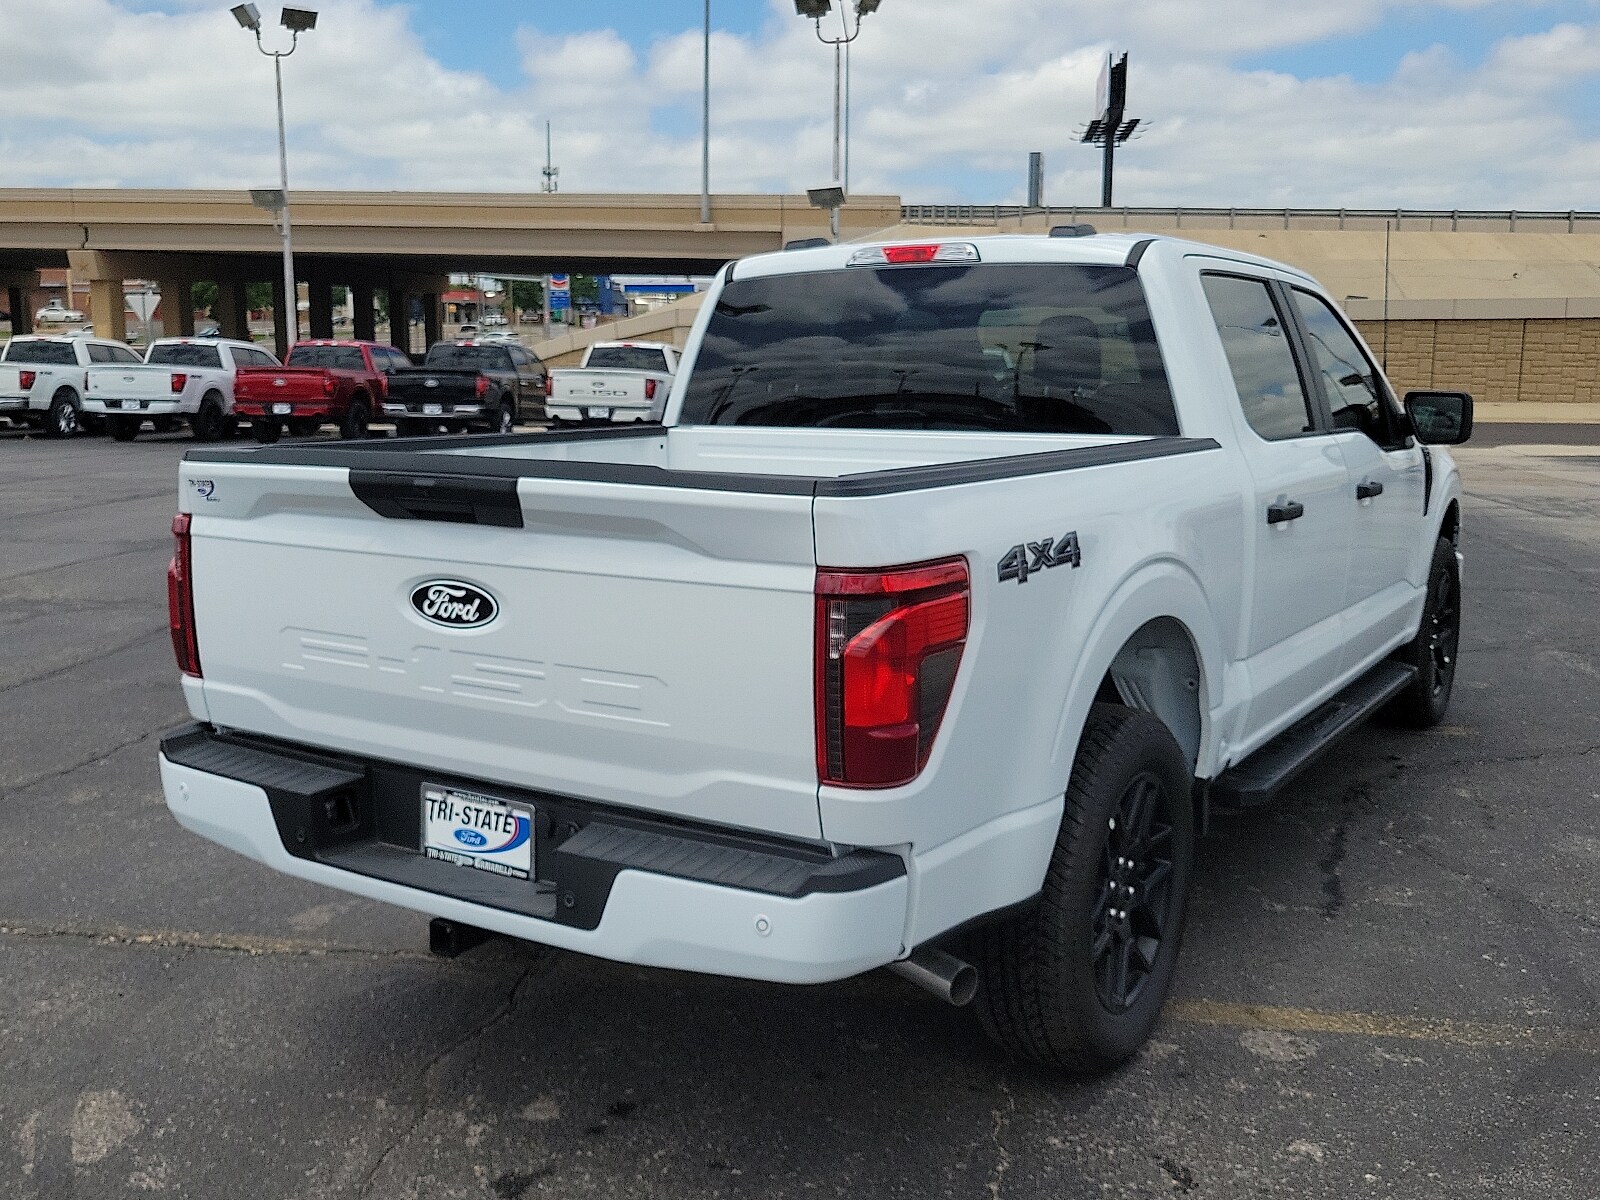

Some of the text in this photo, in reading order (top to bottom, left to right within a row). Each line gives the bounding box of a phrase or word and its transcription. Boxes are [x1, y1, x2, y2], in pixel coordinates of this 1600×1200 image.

[422, 584, 481, 622] Ford
[425, 797, 514, 834] TRI-STATE
[458, 830, 482, 846] Ford
